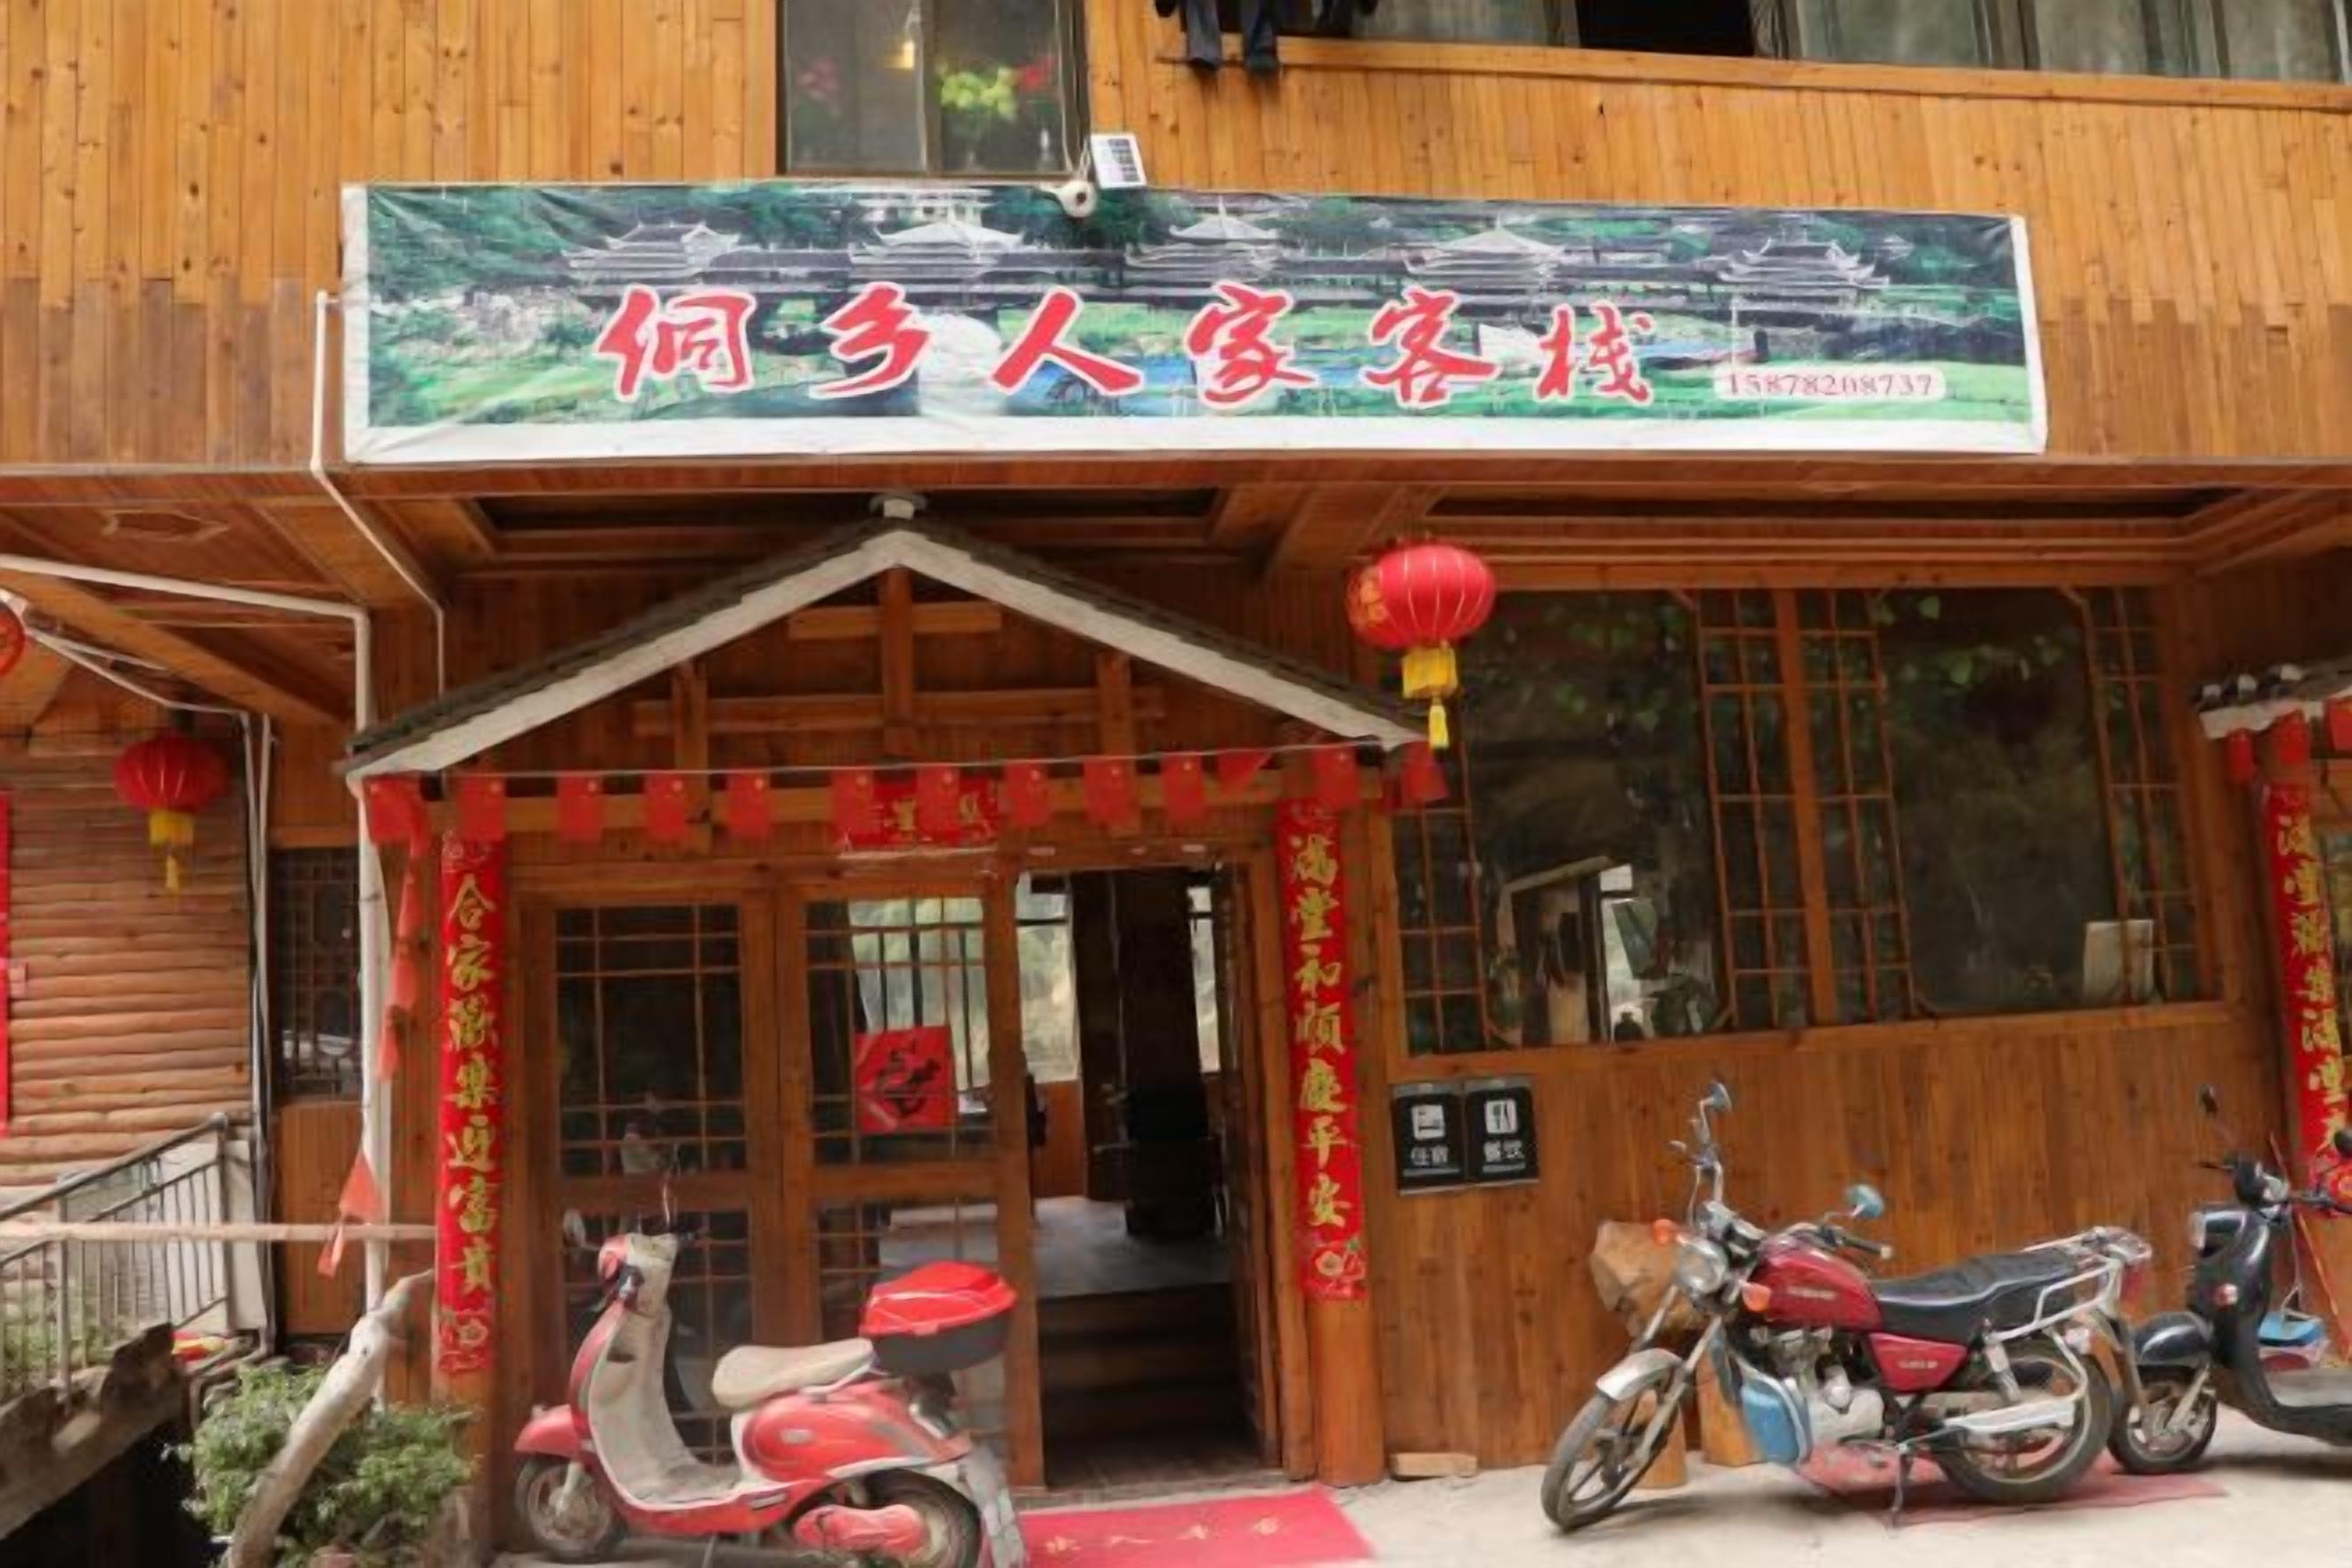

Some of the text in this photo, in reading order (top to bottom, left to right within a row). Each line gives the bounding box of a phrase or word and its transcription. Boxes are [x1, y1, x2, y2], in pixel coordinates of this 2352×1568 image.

[602, 286, 1651, 403] 侗乡人家客栈
[1728, 372, 1933, 397] 15878208737
